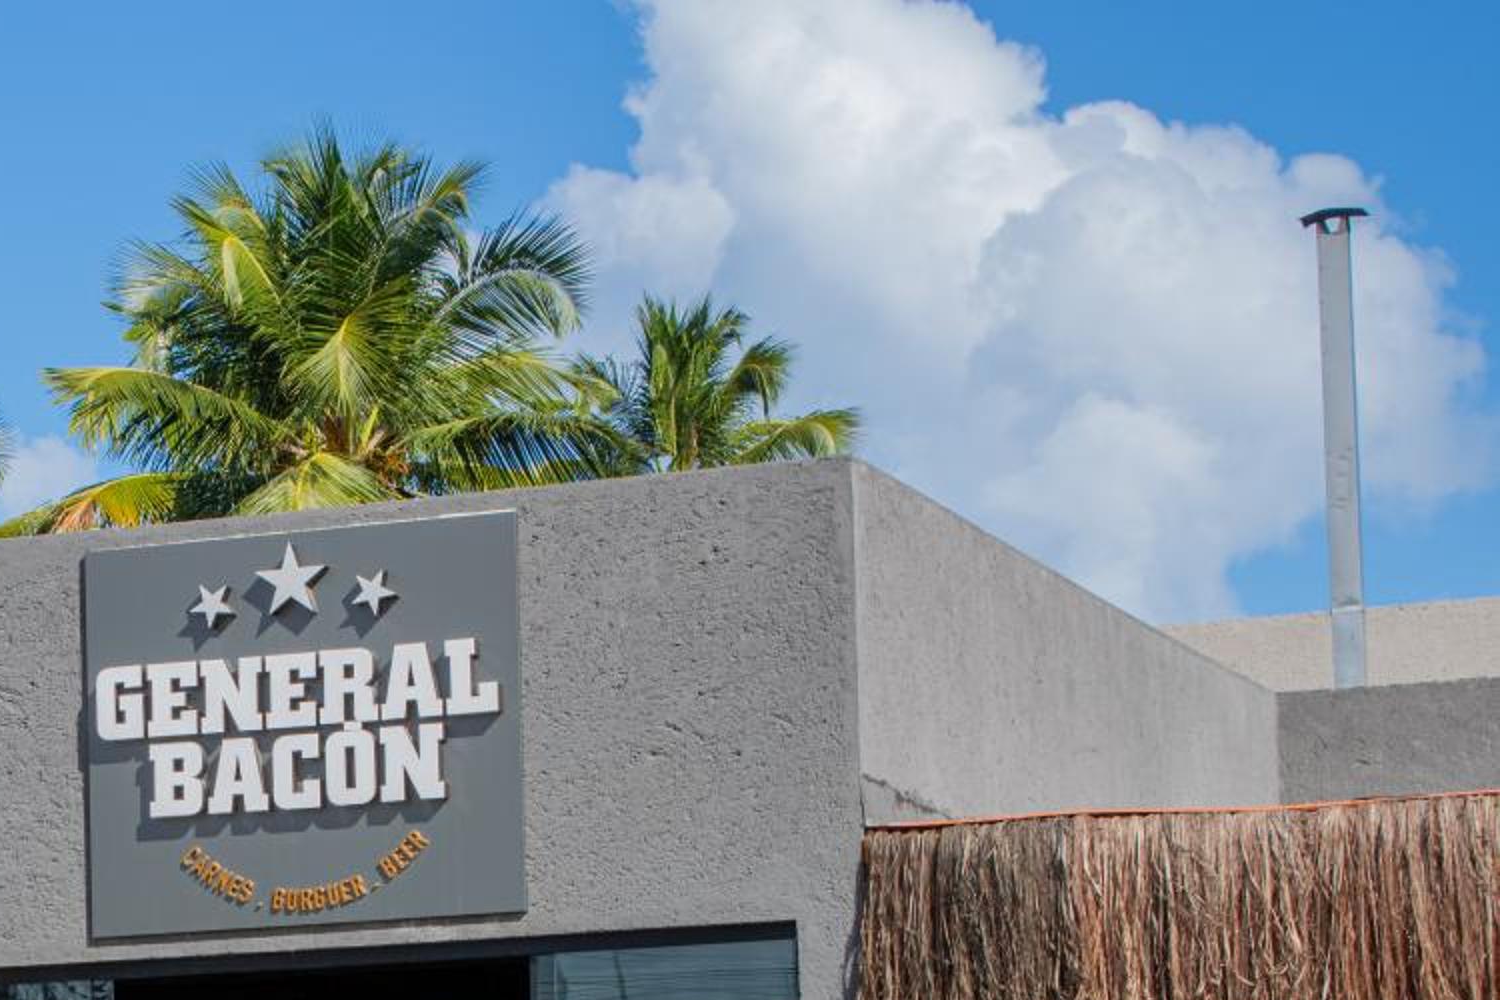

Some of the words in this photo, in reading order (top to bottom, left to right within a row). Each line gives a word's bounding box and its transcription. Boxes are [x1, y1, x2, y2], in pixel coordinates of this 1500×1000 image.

[95, 637, 500, 741] GENERAL
[149, 721, 447, 819] BACON
[181, 846, 256, 904] CARNES
[378, 829, 431, 879] BEER
